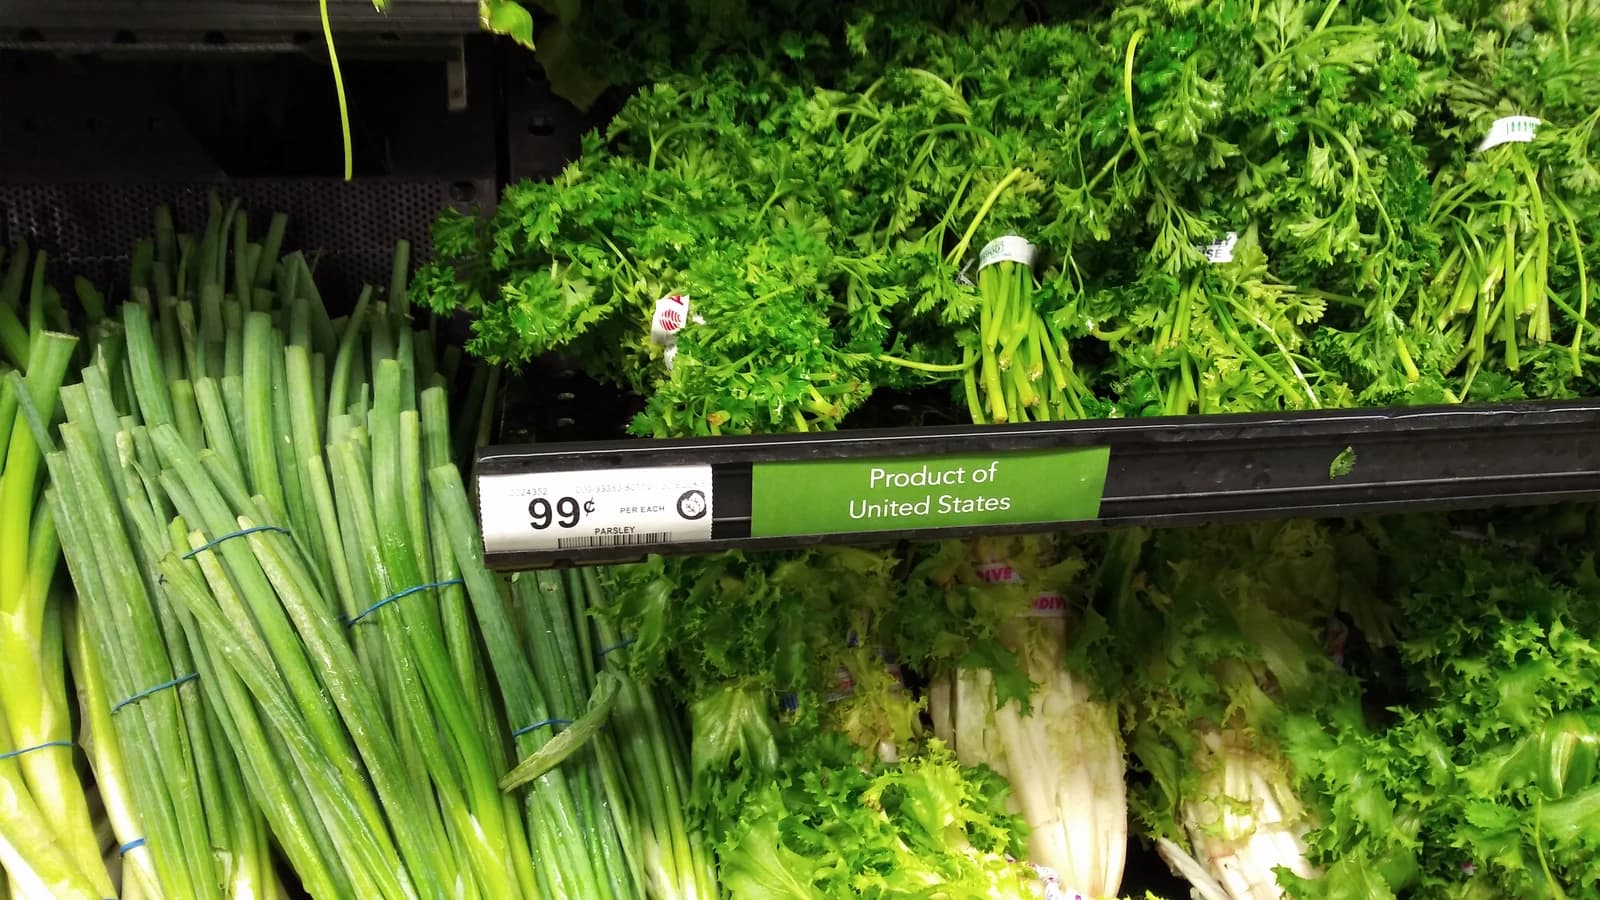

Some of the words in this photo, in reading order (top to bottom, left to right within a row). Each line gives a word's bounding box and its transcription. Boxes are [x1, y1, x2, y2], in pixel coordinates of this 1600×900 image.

[869, 464, 965, 488] Product
[972, 460, 999, 483] of
[528, 496, 596, 530] 99¢
[619, 506, 638, 514] PER
[640, 505, 665, 513] EACH
[849, 495, 930, 519] United
[937, 494, 1011, 515] States
[594, 526, 636, 535] PARSLEY
